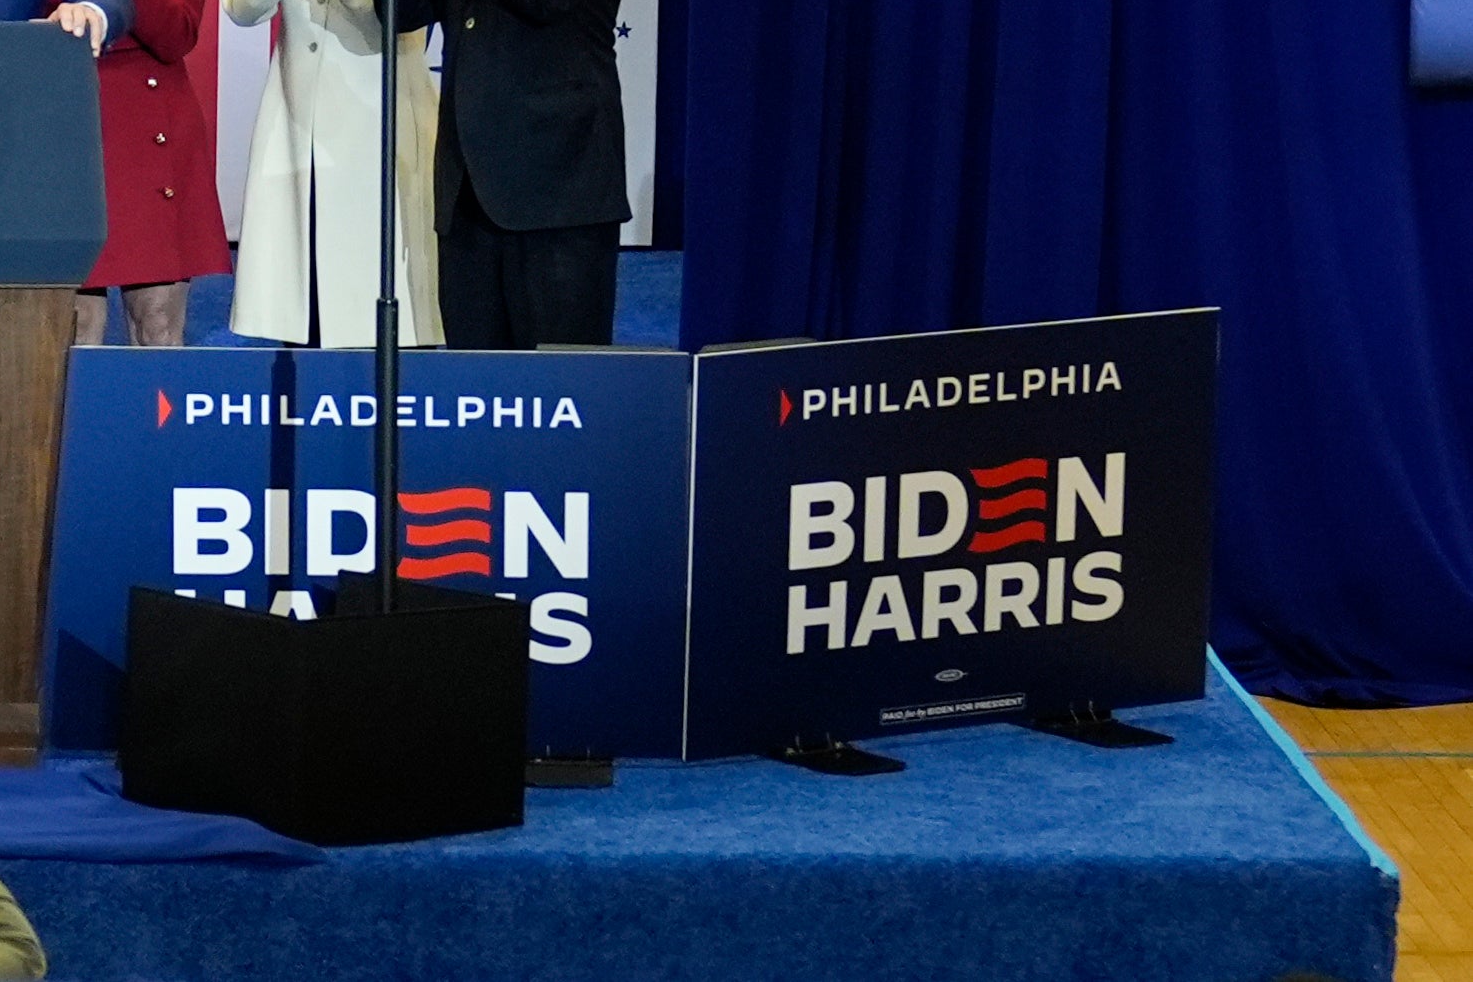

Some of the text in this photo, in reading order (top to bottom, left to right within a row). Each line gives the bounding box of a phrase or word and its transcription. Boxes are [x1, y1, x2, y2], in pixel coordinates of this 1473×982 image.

[186, 393, 583, 429] PHILADELPHIA
[802, 361, 1122, 420] PHILADELPHIA
[173, 487, 590, 580] BIDEN
[788, 452, 1126, 571] BIDEN
[786, 550, 1125, 656] HARRIS
